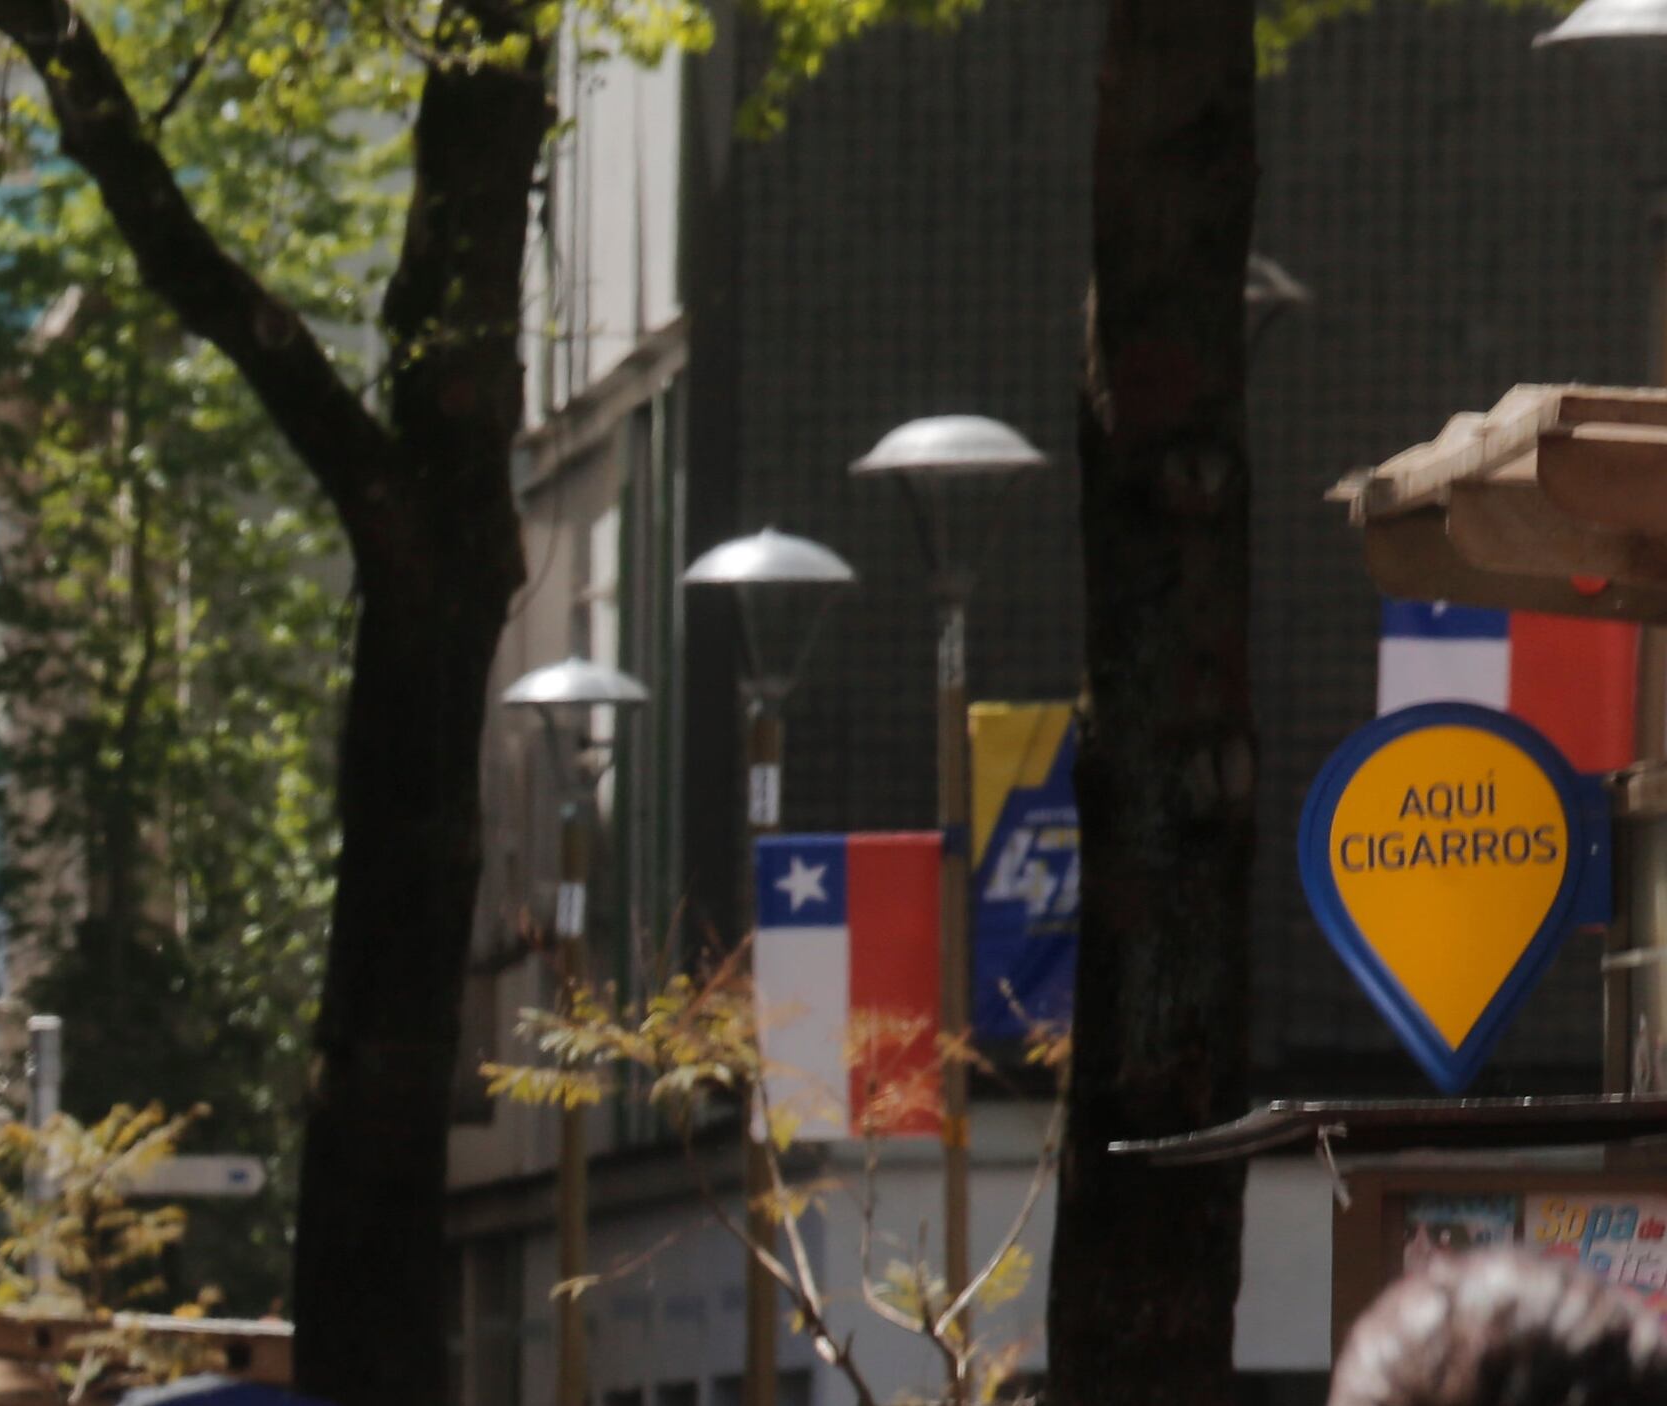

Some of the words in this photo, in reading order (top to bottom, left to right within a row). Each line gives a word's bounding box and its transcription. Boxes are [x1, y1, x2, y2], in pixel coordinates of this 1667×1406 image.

[1399, 768, 1495, 822] AQUÍ
[1340, 824, 1558, 872] CIGARROS
[1535, 1198, 1639, 1264] Sopa
